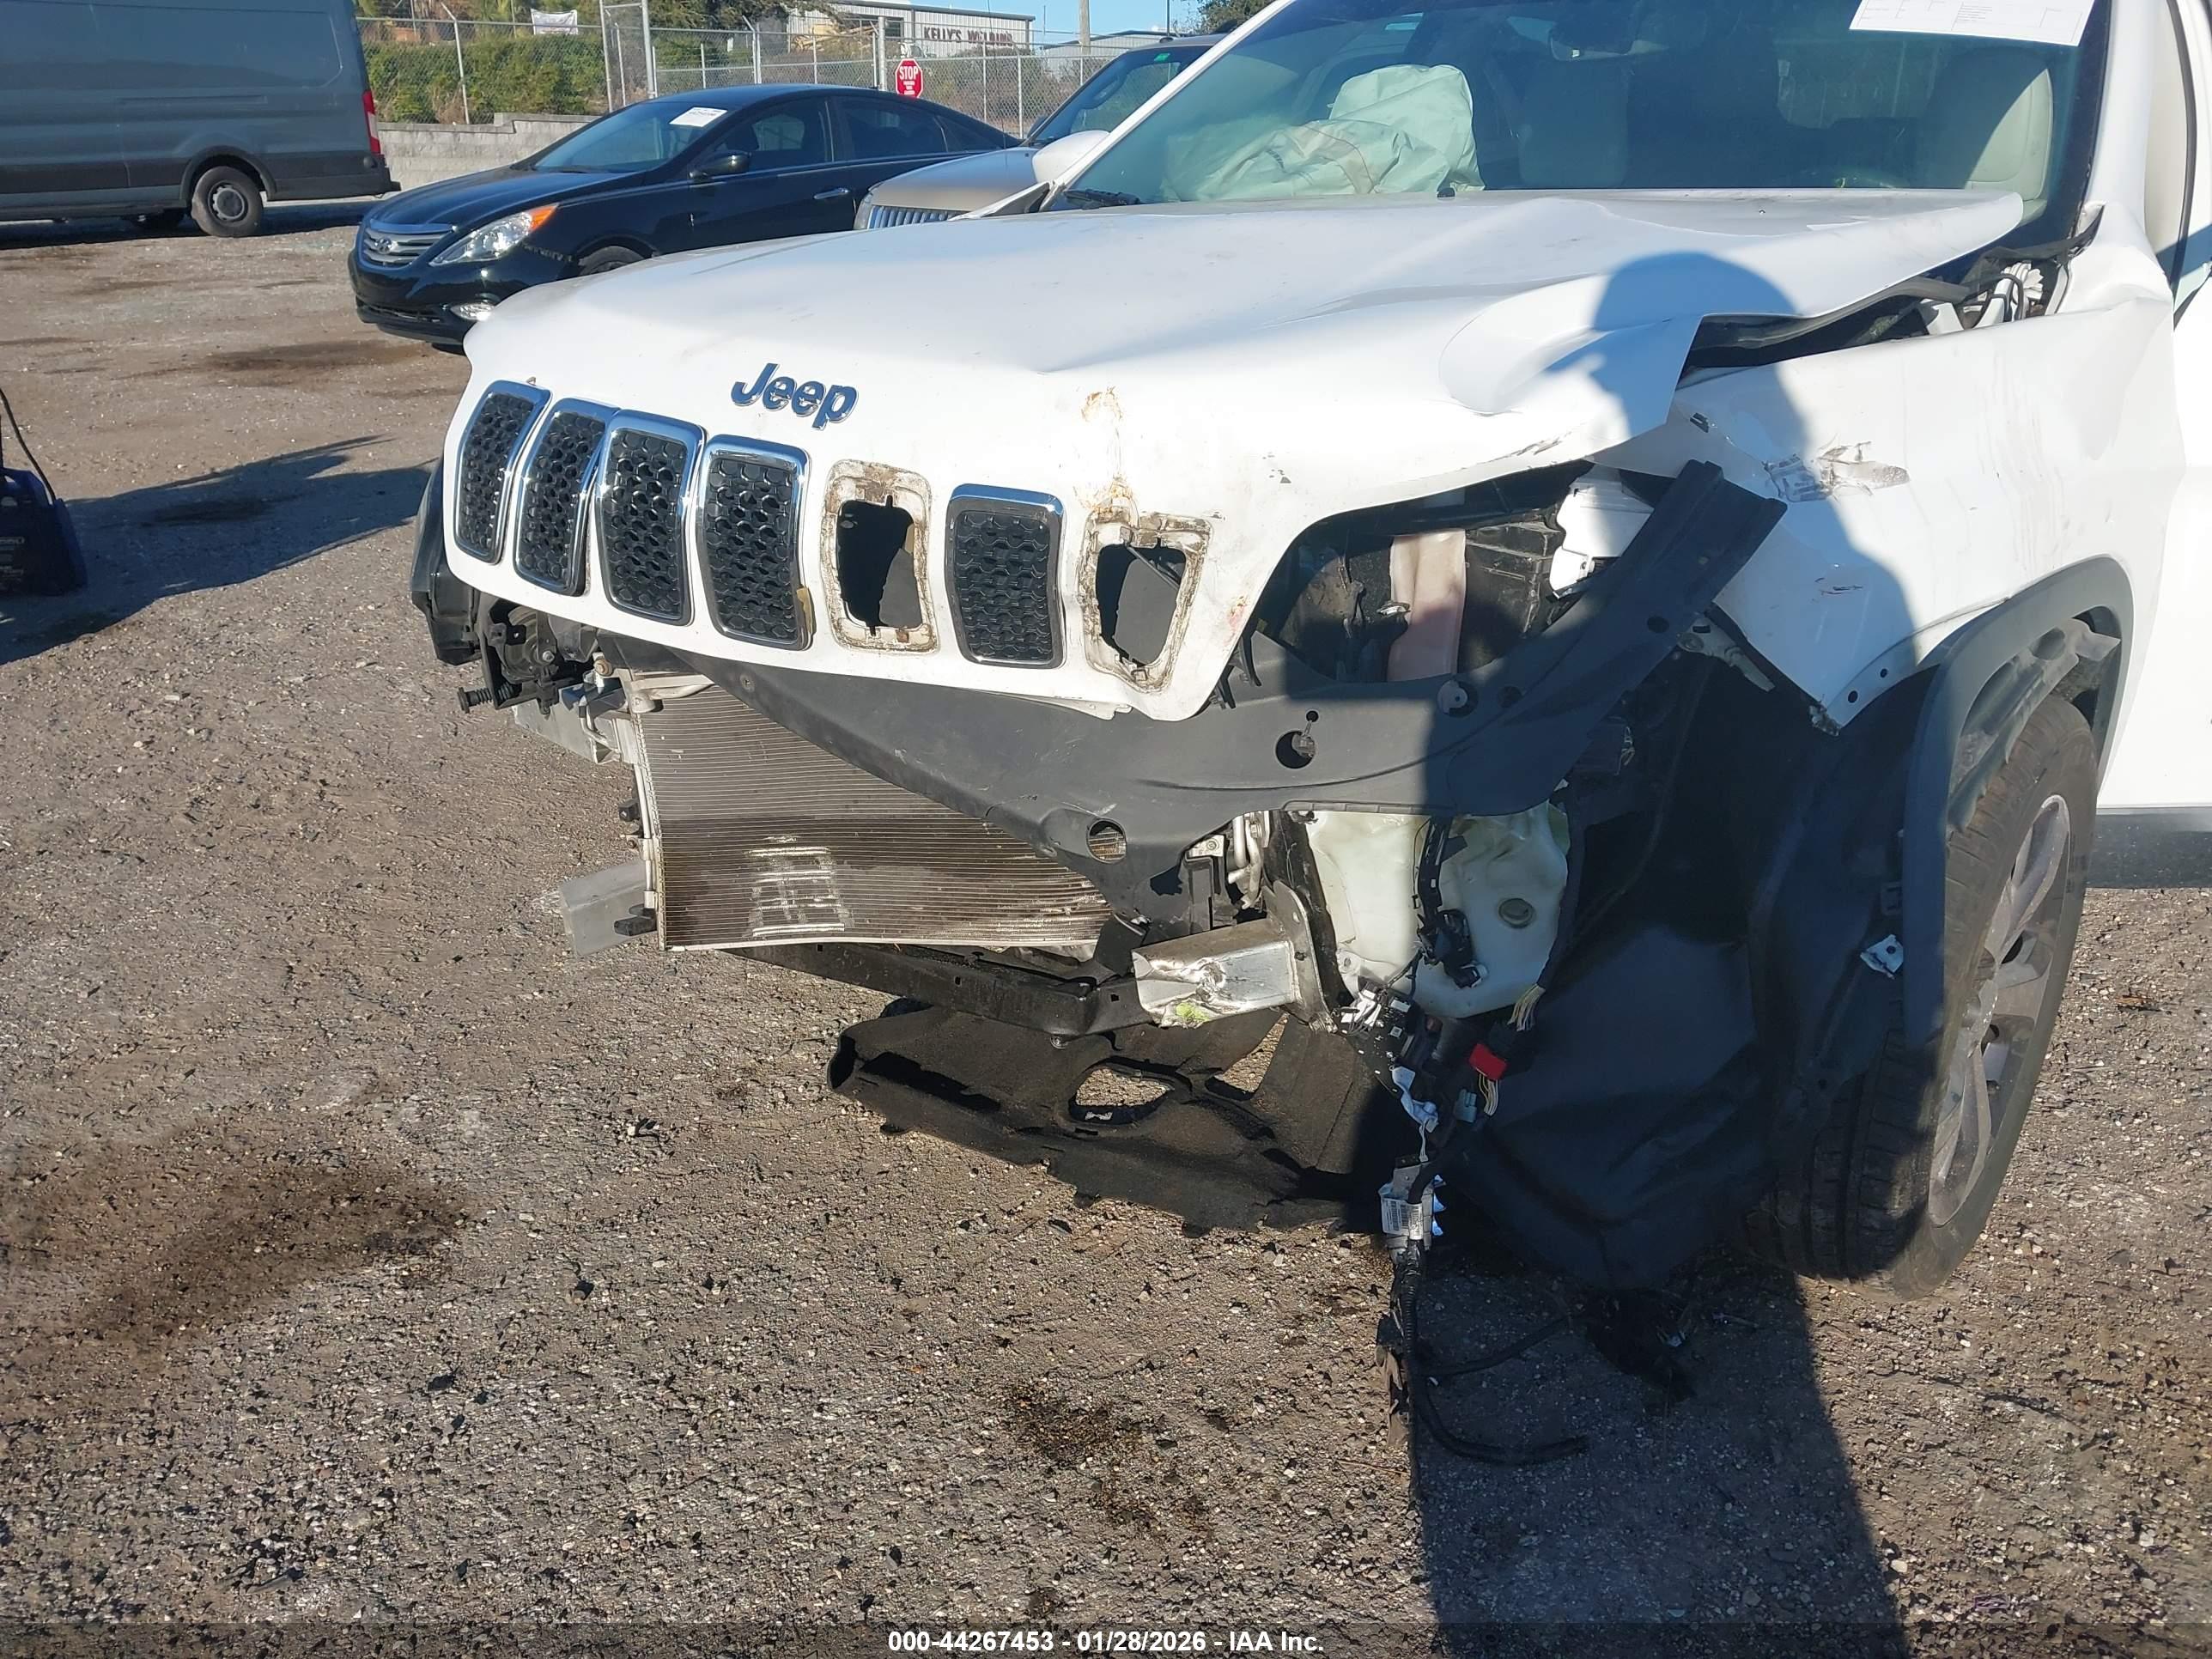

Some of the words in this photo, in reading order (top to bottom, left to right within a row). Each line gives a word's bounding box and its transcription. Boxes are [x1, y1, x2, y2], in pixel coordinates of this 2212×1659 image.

[923, 27, 962, 43] KELLY'S
[899, 65, 919, 80] STOP
[731, 362, 859, 431] Jeep
